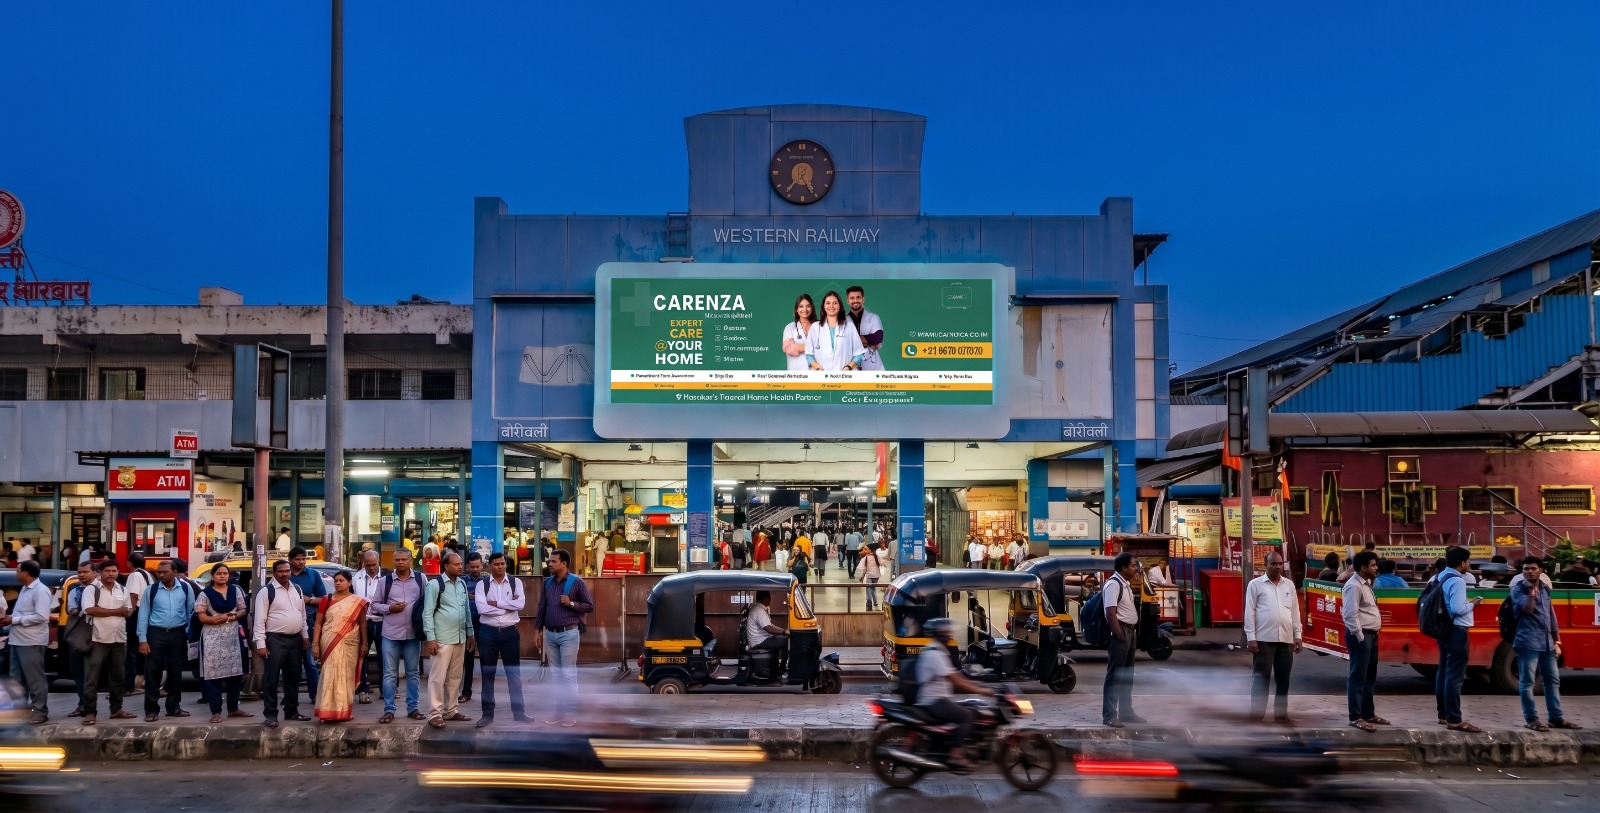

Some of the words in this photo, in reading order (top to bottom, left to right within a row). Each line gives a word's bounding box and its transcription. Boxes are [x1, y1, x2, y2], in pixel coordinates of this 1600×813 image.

[713, 228, 800, 243] WESTERN
[805, 228, 880, 243] RAILWAY
[653, 294, 746, 311] CARENZA
[670, 319, 704, 328] EXPERT
[669, 328, 704, 339] CARE
[655, 340, 703, 352] @YOUR
[655, 353, 704, 365] HOME
[770, 393, 794, 401] Health
[1063, 422, 1109, 438] बोरीवली
[176, 439, 196, 449] ATM
[156, 475, 186, 487] ATM
